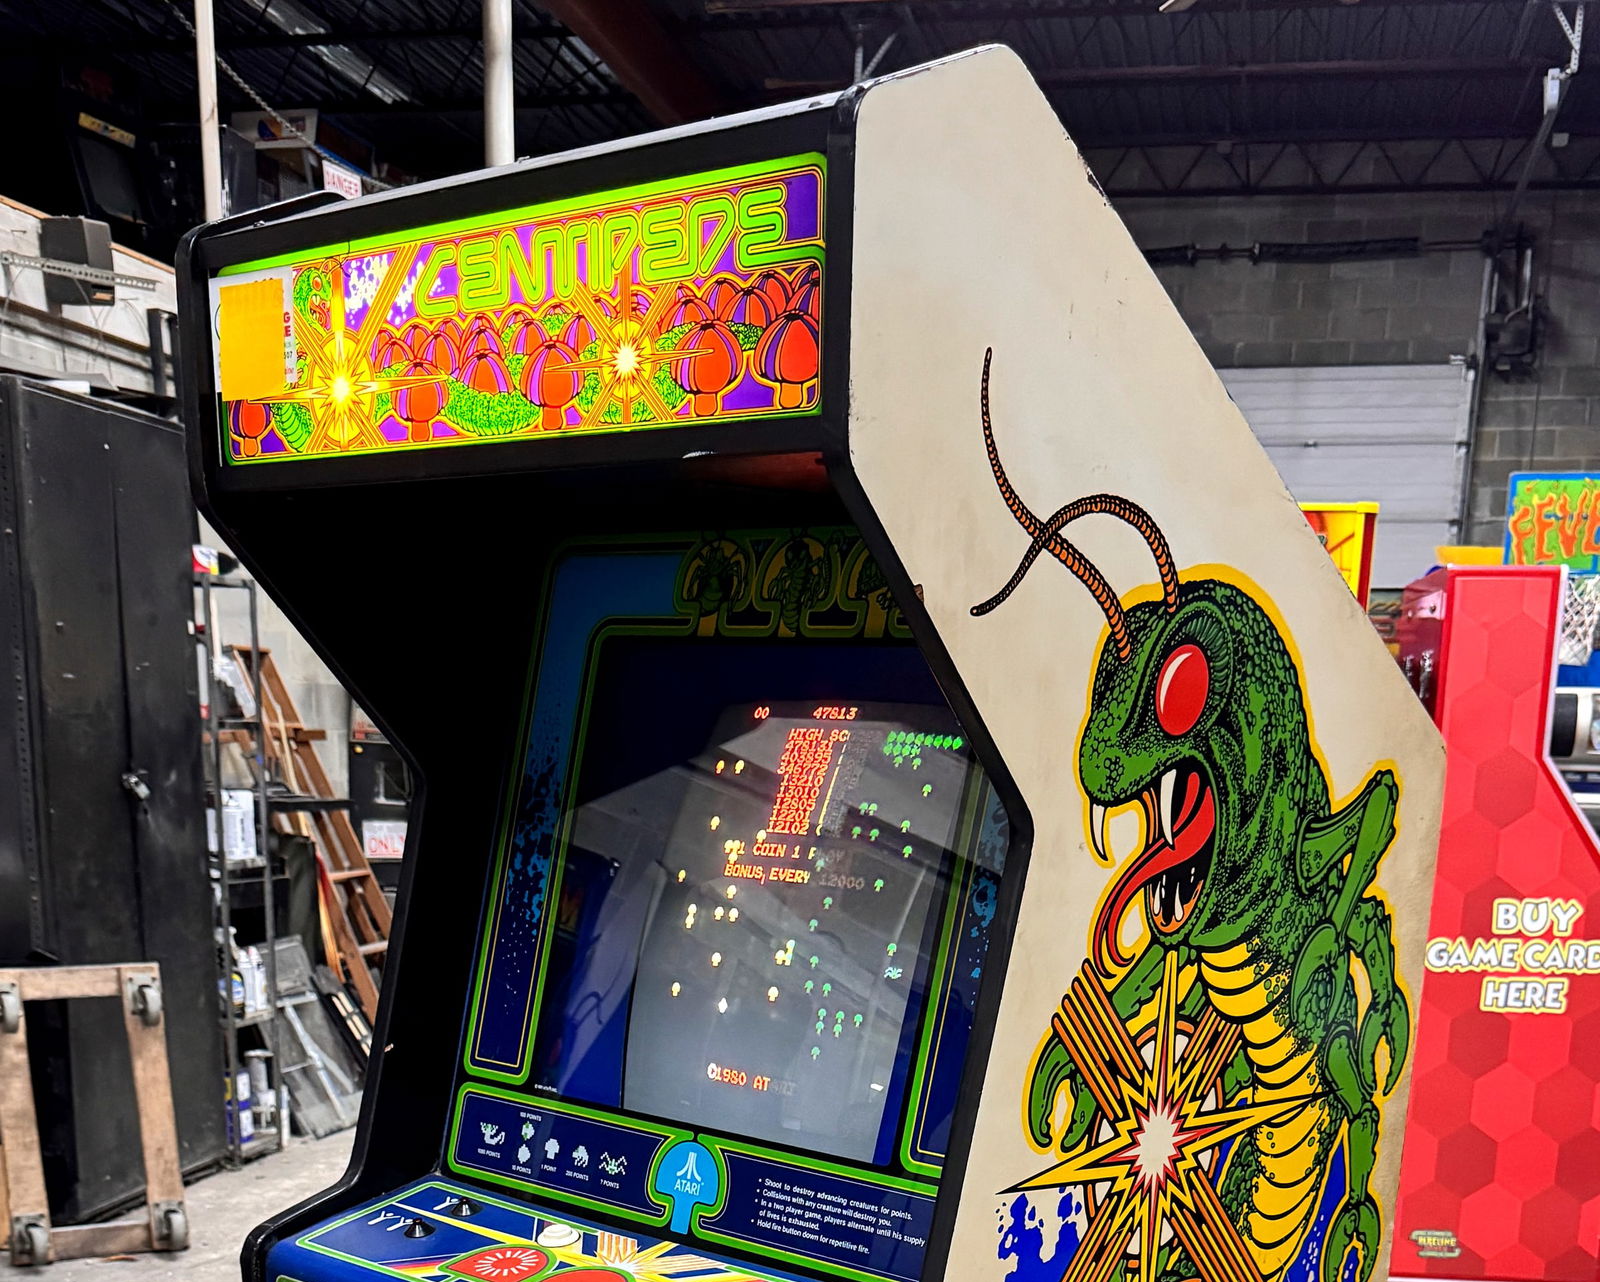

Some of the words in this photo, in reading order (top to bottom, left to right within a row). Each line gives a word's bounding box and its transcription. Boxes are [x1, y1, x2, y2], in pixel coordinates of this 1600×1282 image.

[415, 186, 785, 317] CENTIPEDE
[754, 706, 770, 719] 00
[812, 706, 858, 720] 47813
[788, 728, 824, 741] HIGH
[784, 740, 833, 752] 478131
[780, 750, 832, 763] 403895
[776, 763, 829, 776] 346772
[780, 774, 824, 787] 13210
[776, 785, 820, 798] 13010
[773, 797, 816, 811] 12805
[769, 809, 811, 822] 12201
[766, 821, 809, 835] 12102
[752, 843, 787, 858] COIN
[791, 846, 800, 859] 1
[768, 867, 811, 883] EVERY
[1494, 900, 1580, 935] BUY
[1427, 940, 1519, 969] GAME
[1484, 980, 1564, 1009] HERE
[674, 1179, 700, 1196] ATARI
[764, 1178, 782, 1189] Shoot
[792, 1186, 815, 1198] destroy
[817, 1192, 847, 1206] advancing
[850, 1200, 878, 1212] creatures
[880, 1206, 890, 1214] for
[891, 1210, 912, 1220] points.
[763, 1189, 790, 1202] Collisions
[792, 1197, 804, 1205] with
[805, 1201, 816, 1209] any
[817, 1202, 841, 1214] creature
[842, 1209, 852, 1217] will
[853, 1212, 876, 1224] destroy
[879, 1218, 892, 1226] you.
[767, 1211, 780, 1220] lives
[788, 1218, 820, 1231] exhausted.
[785, 1206, 804, 1215] player
[824, 1215, 846, 1226] players
[847, 1221, 874, 1233] alternate
[876, 1229, 892, 1237] until
[892, 1231, 902, 1240] his
[904, 1235, 925, 1248] supply
[757, 1219, 771, 1229] Hold
[772, 1223, 781, 1232] fire
[782, 1225, 802, 1236] button
[802, 1231, 818, 1242] down
[820, 1235, 829, 1244] for
[829, 1238, 857, 1251] repetitive
[858, 1244, 870, 1254] fire.
